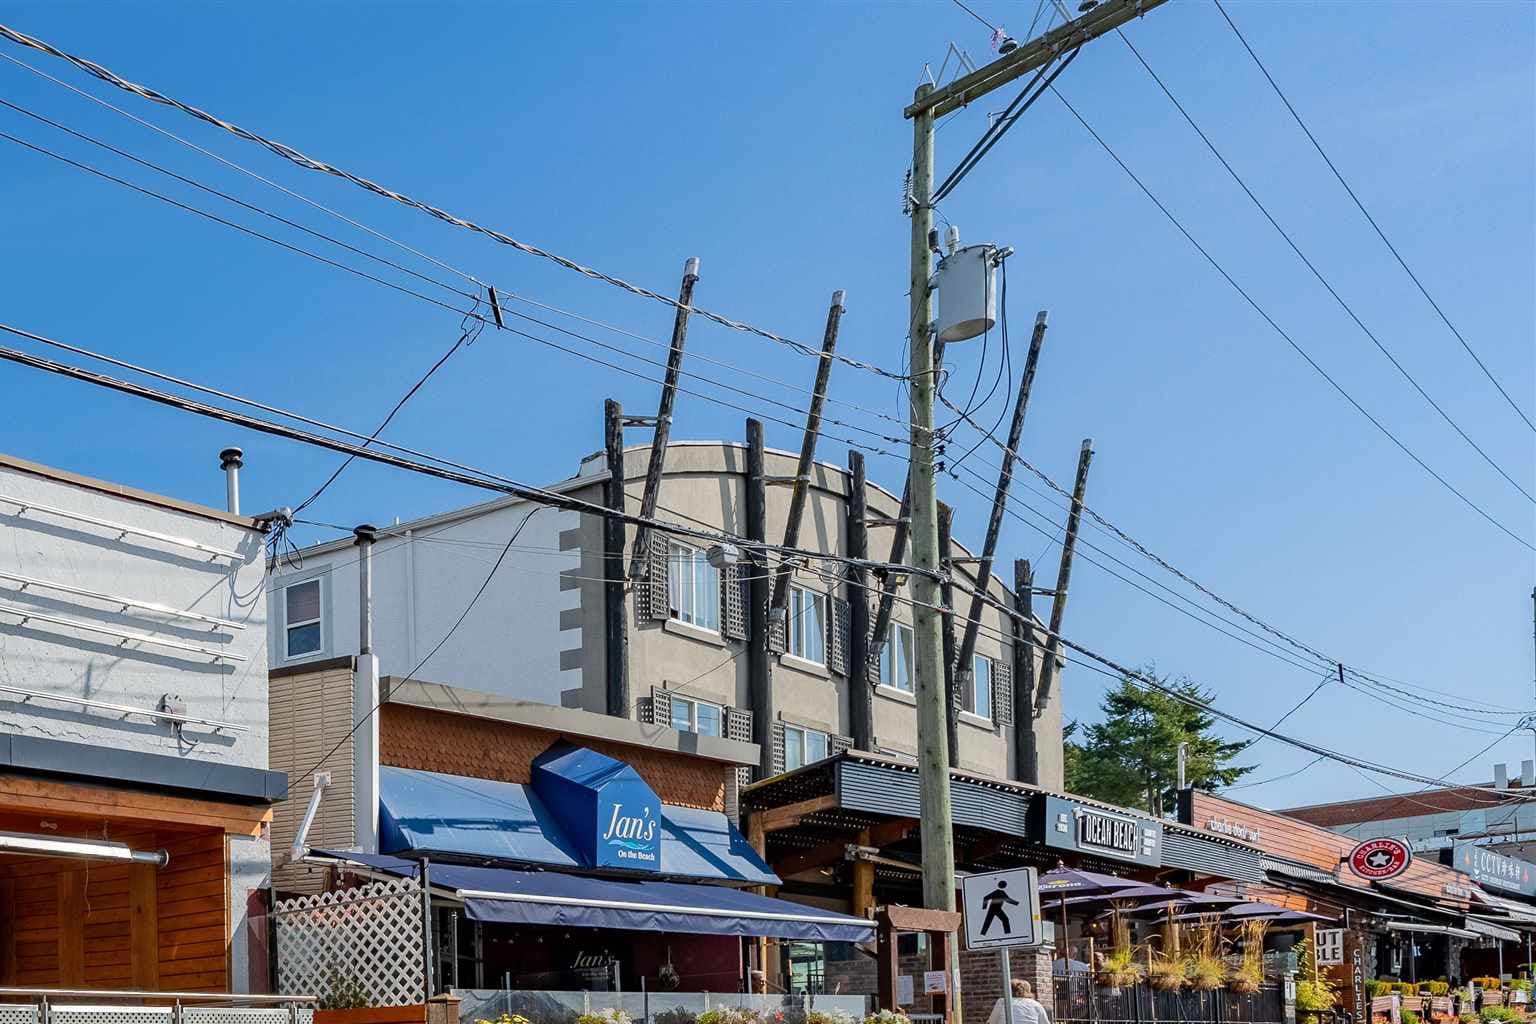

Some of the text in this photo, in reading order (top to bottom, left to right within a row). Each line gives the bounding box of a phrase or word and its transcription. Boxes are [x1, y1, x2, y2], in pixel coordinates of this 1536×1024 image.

[603, 803, 656, 841] Jan's
[1086, 814, 1139, 852] OCEAN BEACH
[618, 849, 655, 861] On the Beach
[1352, 948, 1363, 1020] CHARLIES
